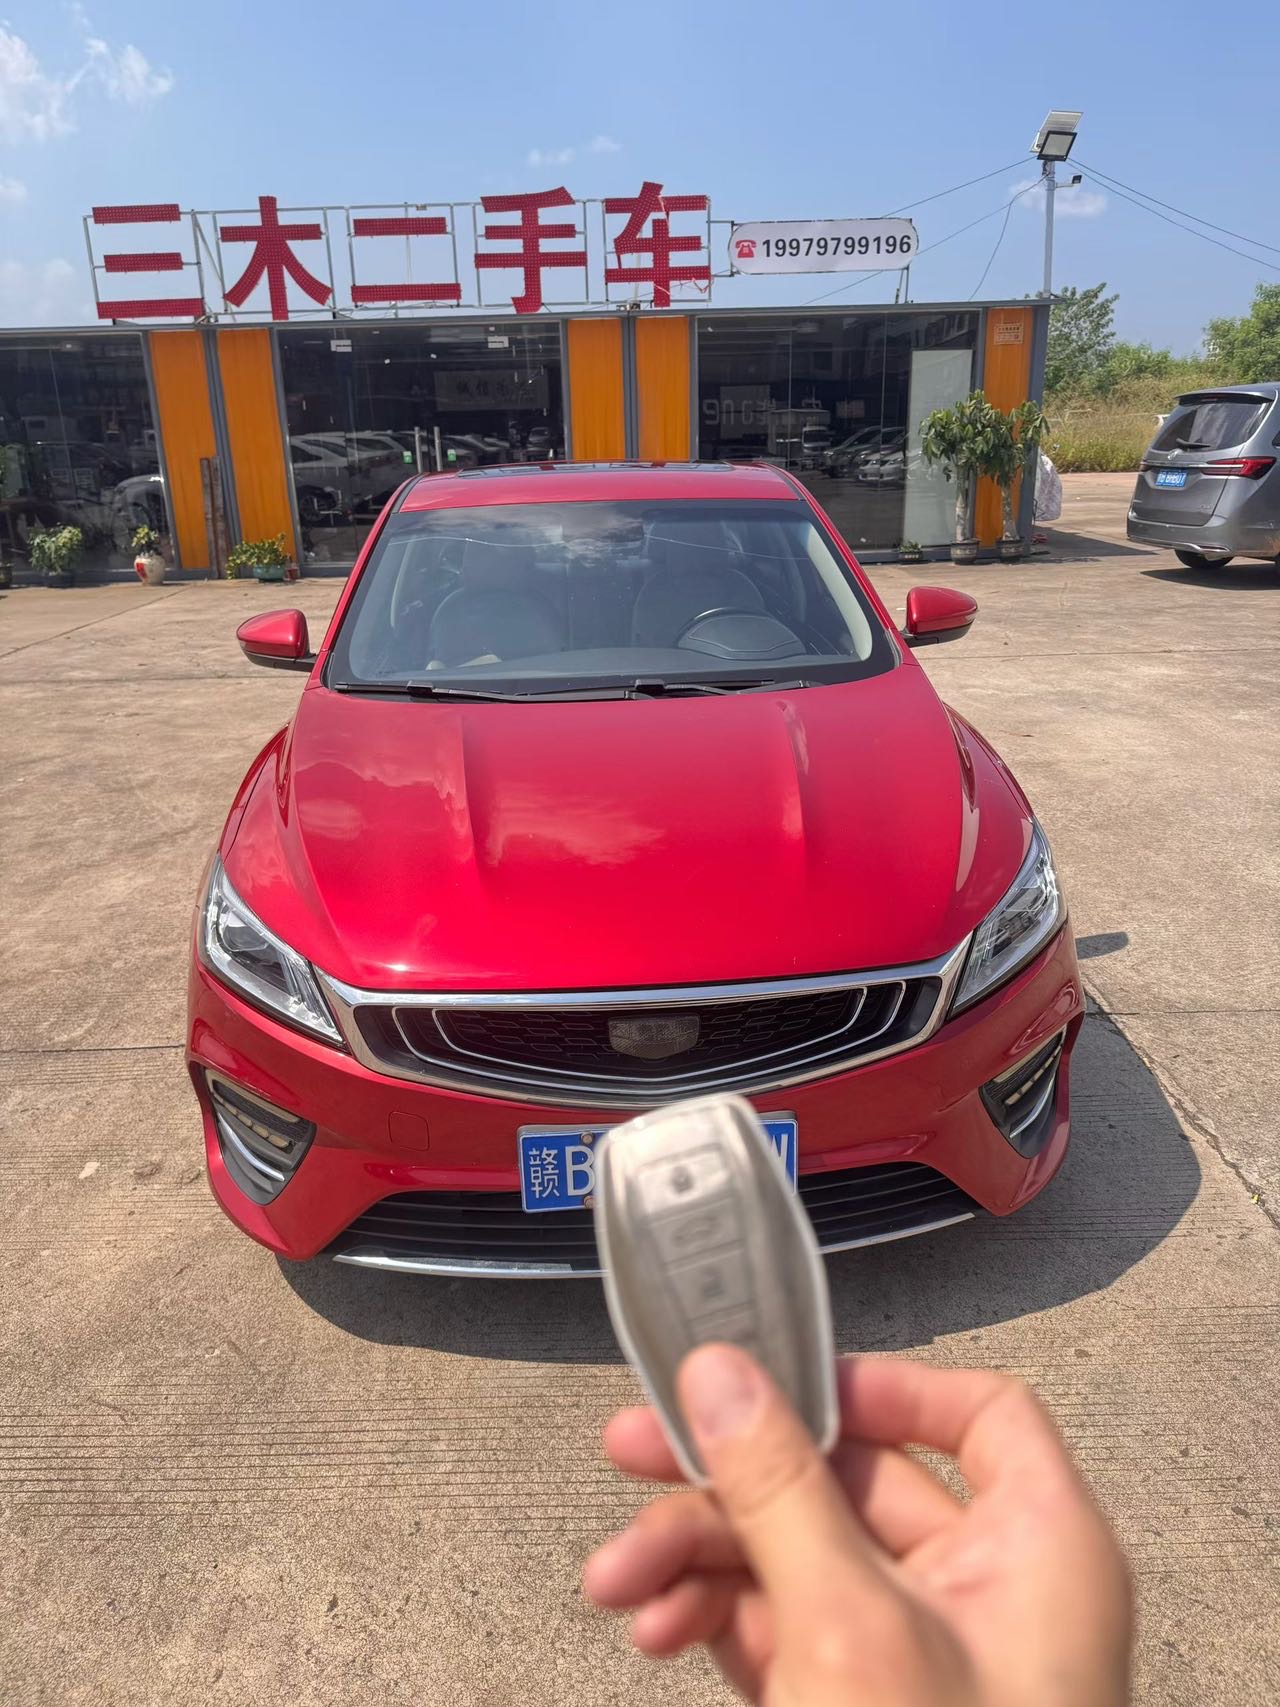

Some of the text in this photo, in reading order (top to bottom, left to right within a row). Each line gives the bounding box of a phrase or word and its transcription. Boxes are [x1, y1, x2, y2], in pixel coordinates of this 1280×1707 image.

[92, 181, 711, 320] 三木二手车
[762, 235, 912, 258] 19979799196
